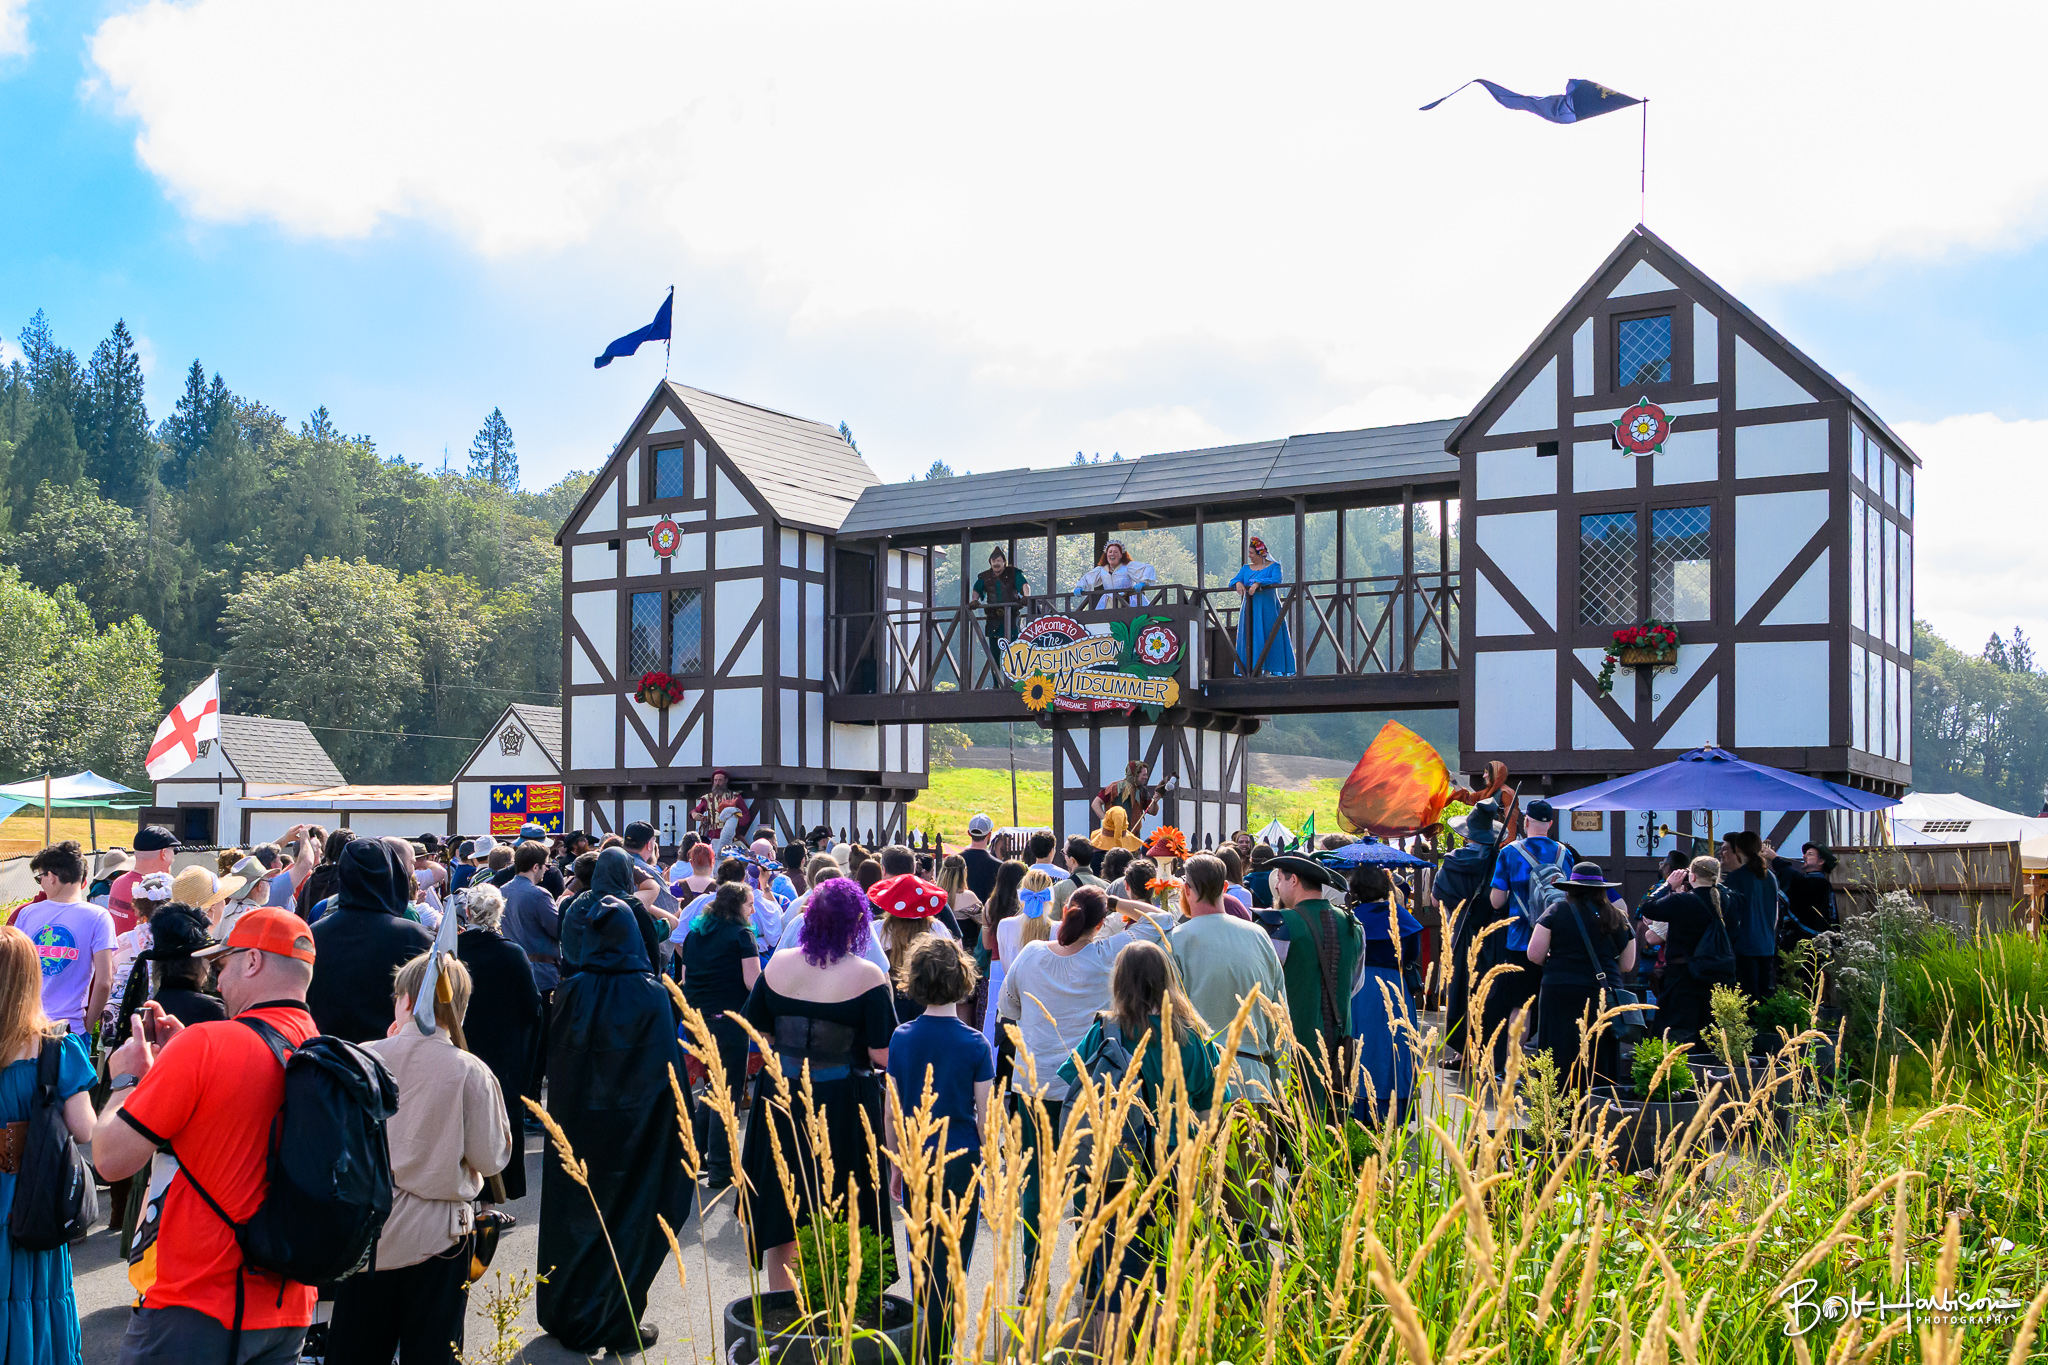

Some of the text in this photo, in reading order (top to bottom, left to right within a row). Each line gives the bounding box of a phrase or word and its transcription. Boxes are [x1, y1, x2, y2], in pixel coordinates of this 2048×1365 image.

[1024, 621, 1077, 638] Welcome to
[1038, 632, 1063, 648] The
[998, 637, 1124, 677] WASHINGTON
[1053, 667, 1169, 699] MIDSUMMER
[1053, 697, 1112, 710] RENAISSANCE FAIRE
